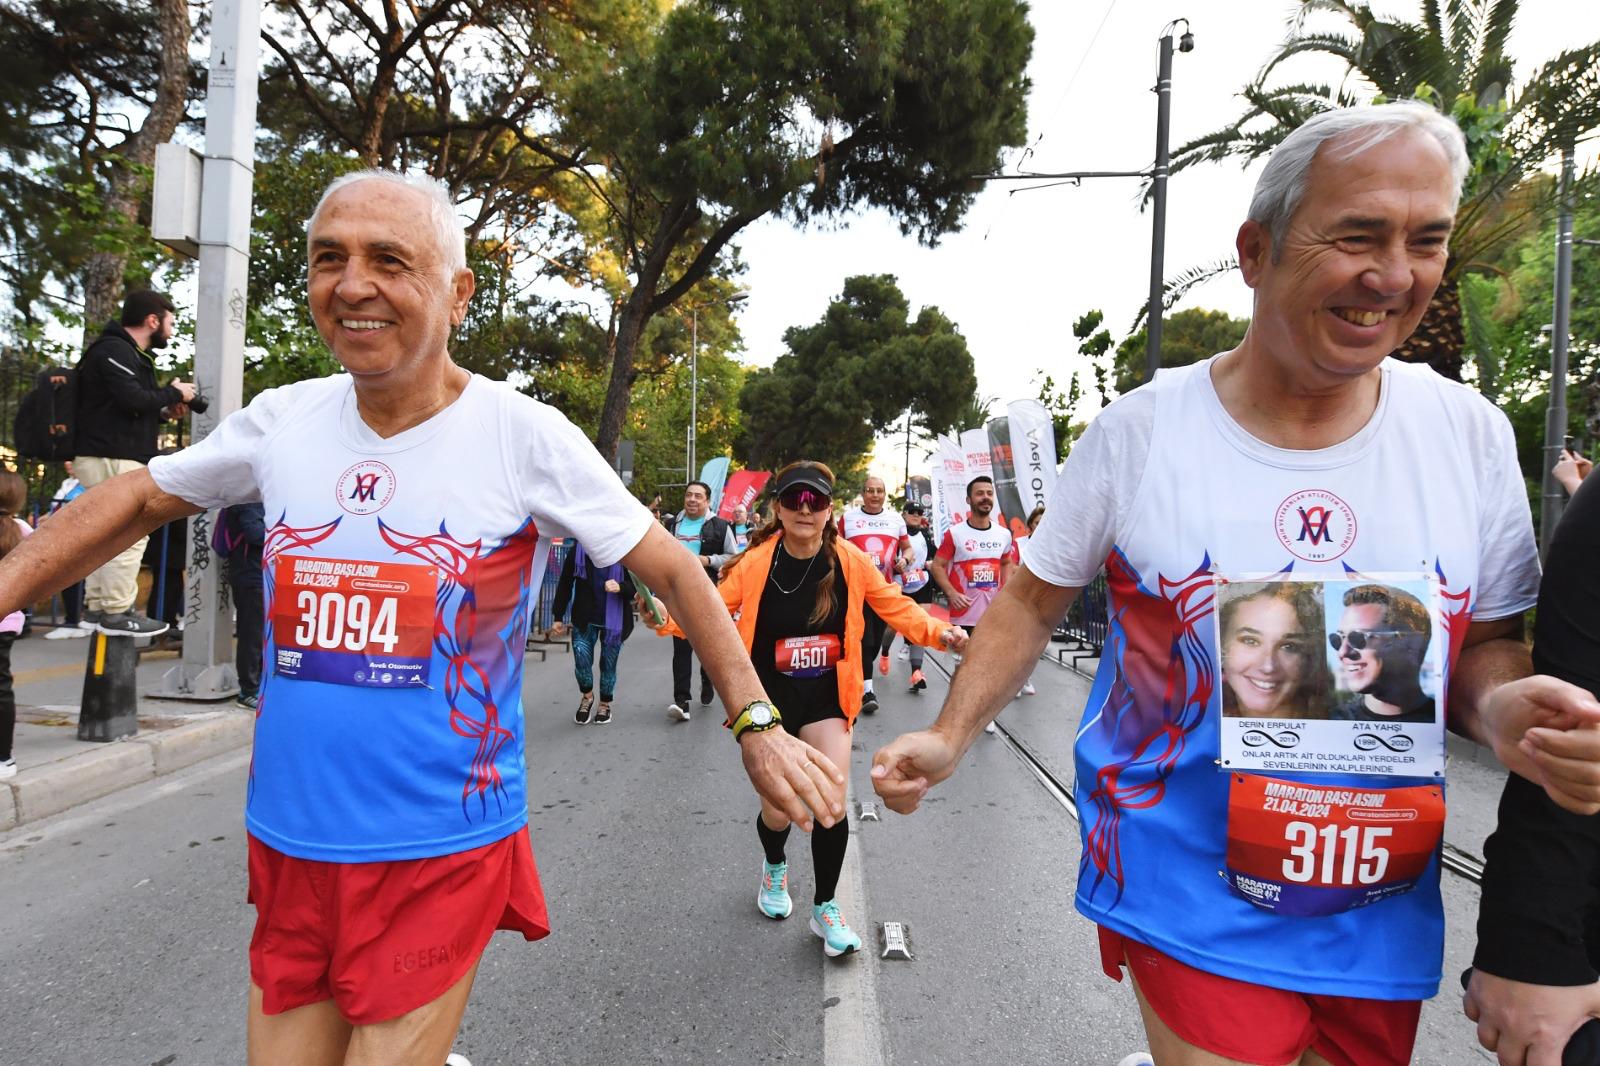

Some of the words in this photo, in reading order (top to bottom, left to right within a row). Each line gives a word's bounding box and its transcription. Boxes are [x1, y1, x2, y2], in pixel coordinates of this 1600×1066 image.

[295, 590, 399, 653] 3094
[790, 646, 827, 669] 4501
[1239, 721, 1265, 729] DERİN
[1267, 722, 1306, 730] ERPULAT
[1352, 723, 1371, 731] ATA
[1374, 723, 1403, 732] YAHŞİ
[1242, 750, 1271, 758] ONLAR
[1317, 753, 1366, 761] OLDUKLARI
[1368, 755, 1416, 763] YERDELER
[1331, 764, 1394, 773] KALPLERİNDE
[1264, 782, 1324, 803] MARATON
[1323, 790, 1387, 808] BAŞLASIN!
[1263, 797, 1331, 818] 21.04.2024
[1351, 811, 1414, 820] maratonizmir.org
[1282, 820, 1393, 885] 3115
[1236, 874, 1282, 893] MARATON
